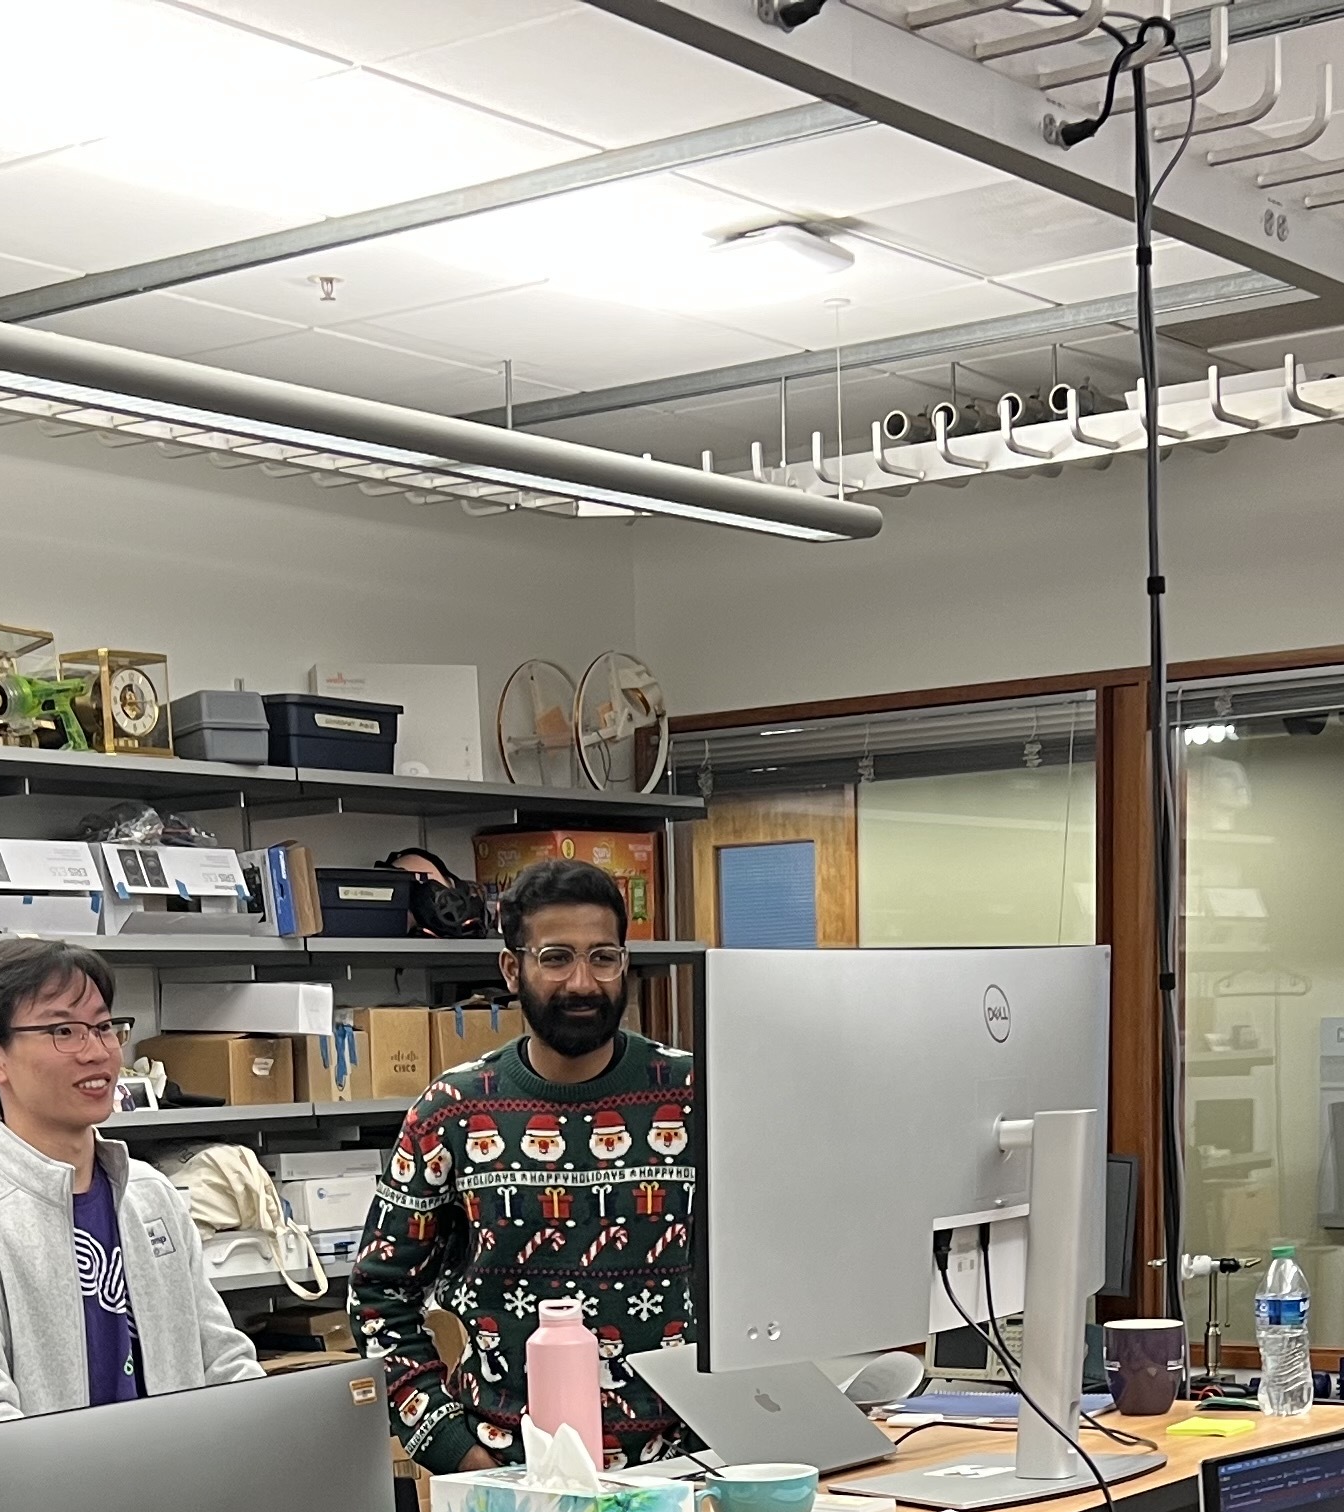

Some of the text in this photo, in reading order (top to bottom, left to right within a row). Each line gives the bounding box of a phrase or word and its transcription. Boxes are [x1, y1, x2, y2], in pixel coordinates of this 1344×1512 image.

[987, 1006, 1009, 1022] DELL
[530, 1171, 569, 1183] HAPPY
[571, 1168, 626, 1184] HOLIDAYS
[639, 1166, 674, 1178] HAPPY
